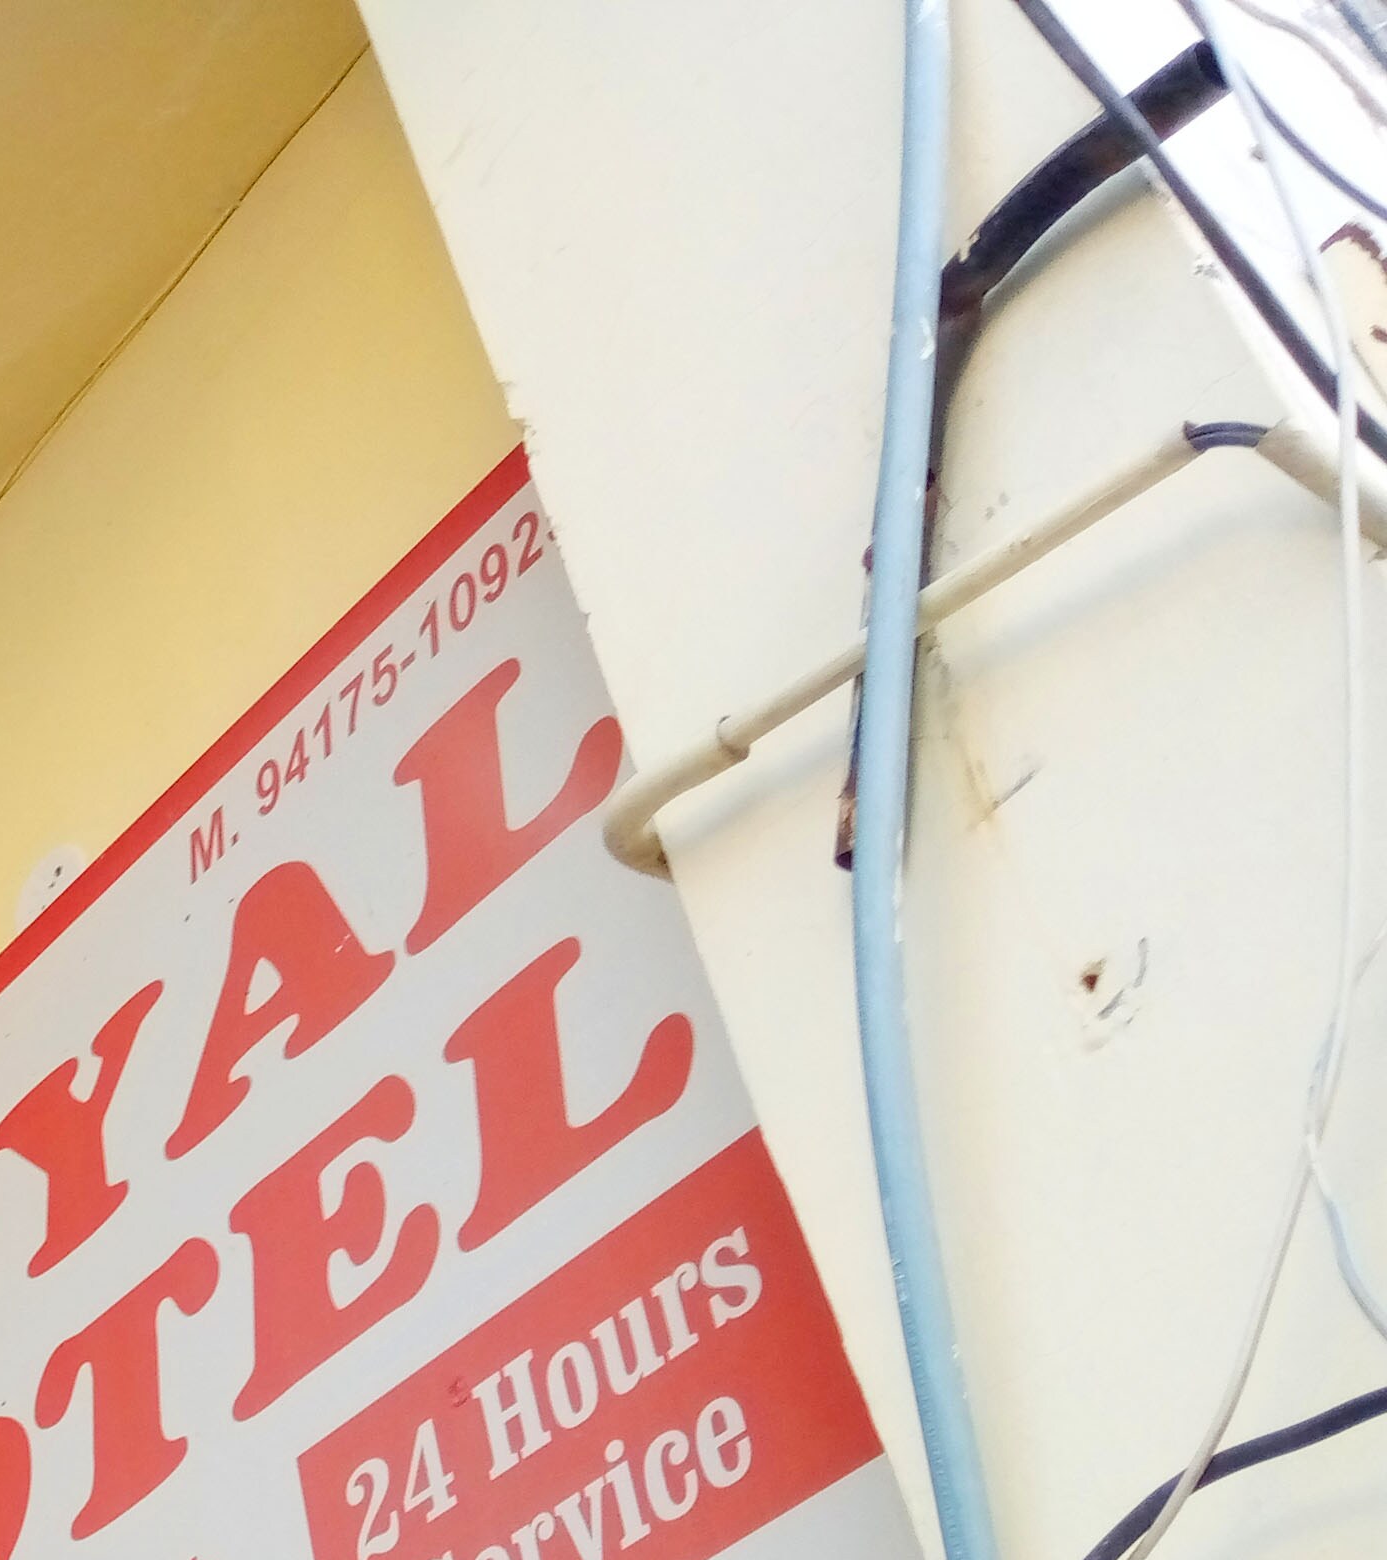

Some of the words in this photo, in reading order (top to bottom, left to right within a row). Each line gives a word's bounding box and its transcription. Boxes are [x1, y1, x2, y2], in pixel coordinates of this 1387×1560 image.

[189, 806, 239, 884] M.
[256, 511, 557, 816] 94175-1092
[472, 1226, 763, 1480] Hours
